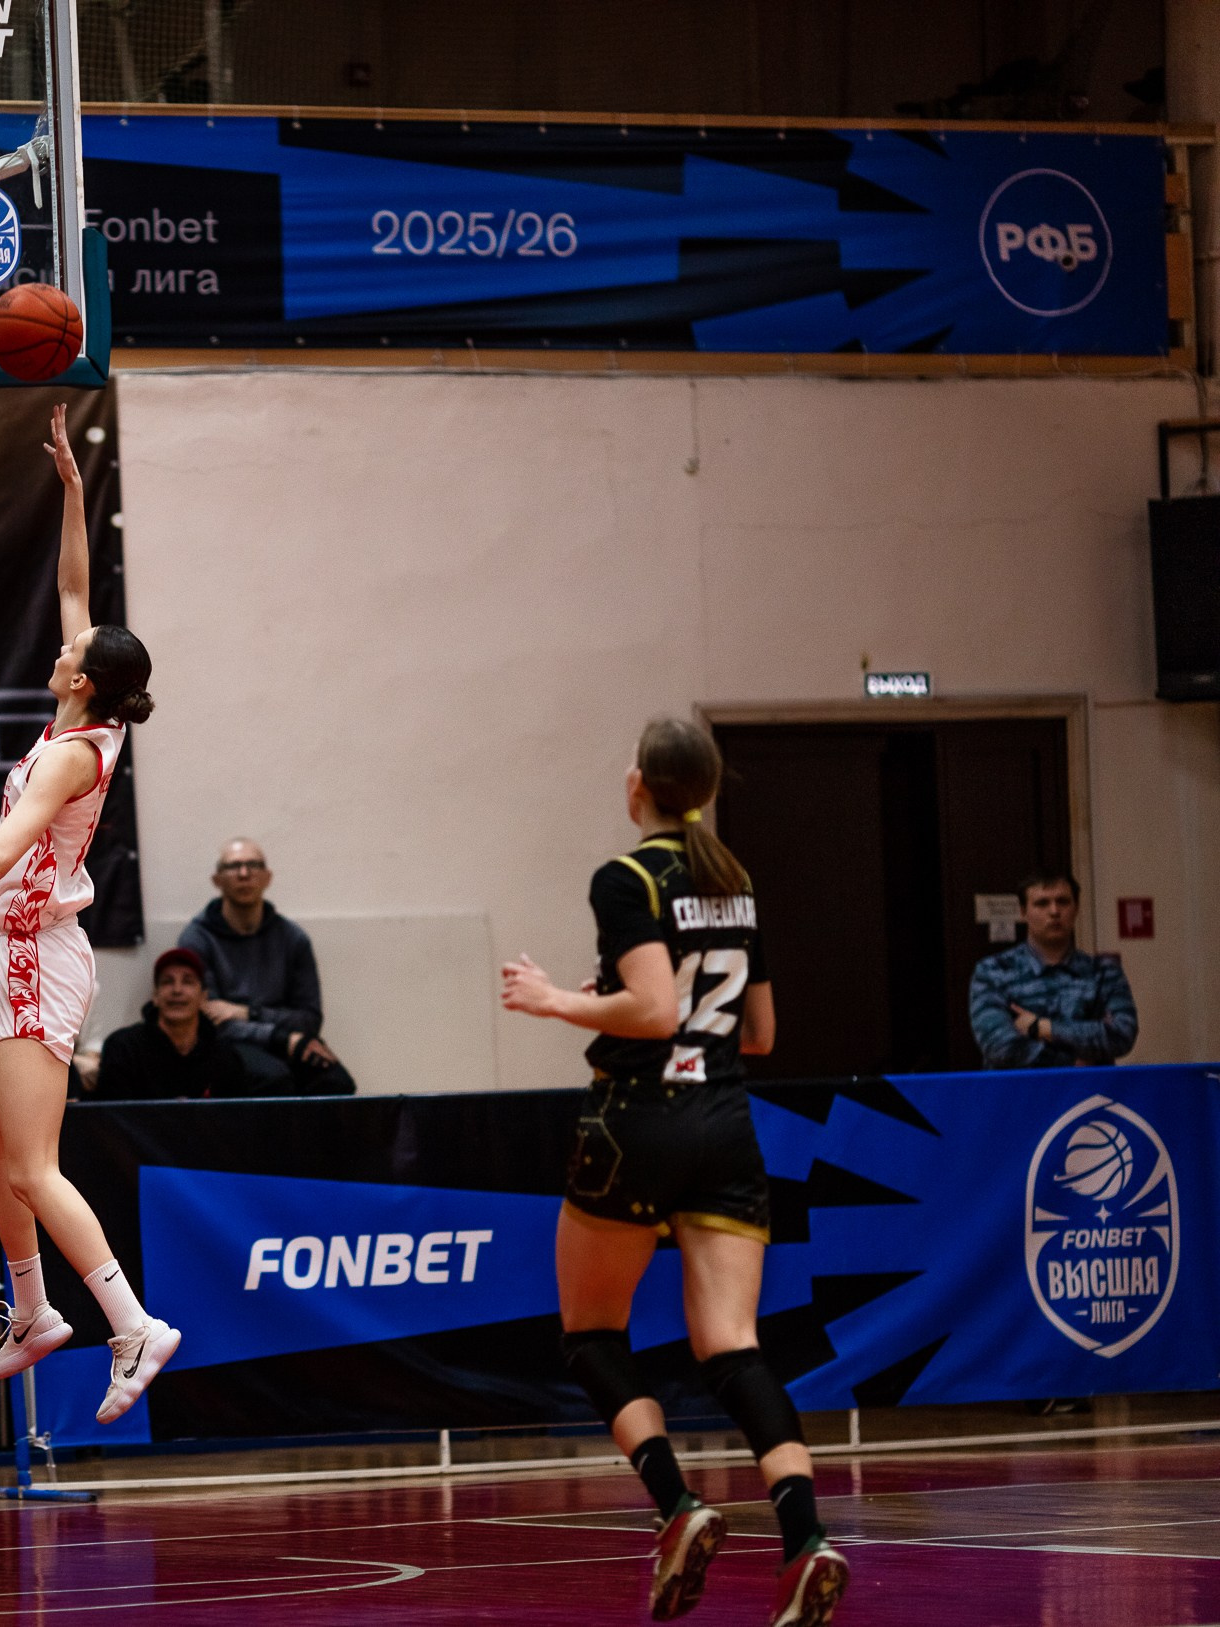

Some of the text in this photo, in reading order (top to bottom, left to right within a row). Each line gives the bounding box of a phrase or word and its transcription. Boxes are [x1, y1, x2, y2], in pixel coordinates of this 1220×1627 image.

[372, 209, 577, 258] 2025/26
[996, 222, 1098, 262] РФБ
[130, 268, 220, 295] лига
[1062, 1227, 1147, 1250] FONBET
[244, 1229, 493, 1290] FONBET
[1047, 1256, 1159, 1300] ВЫСШАЯ
[1091, 1300, 1126, 1324] ЛИГА
